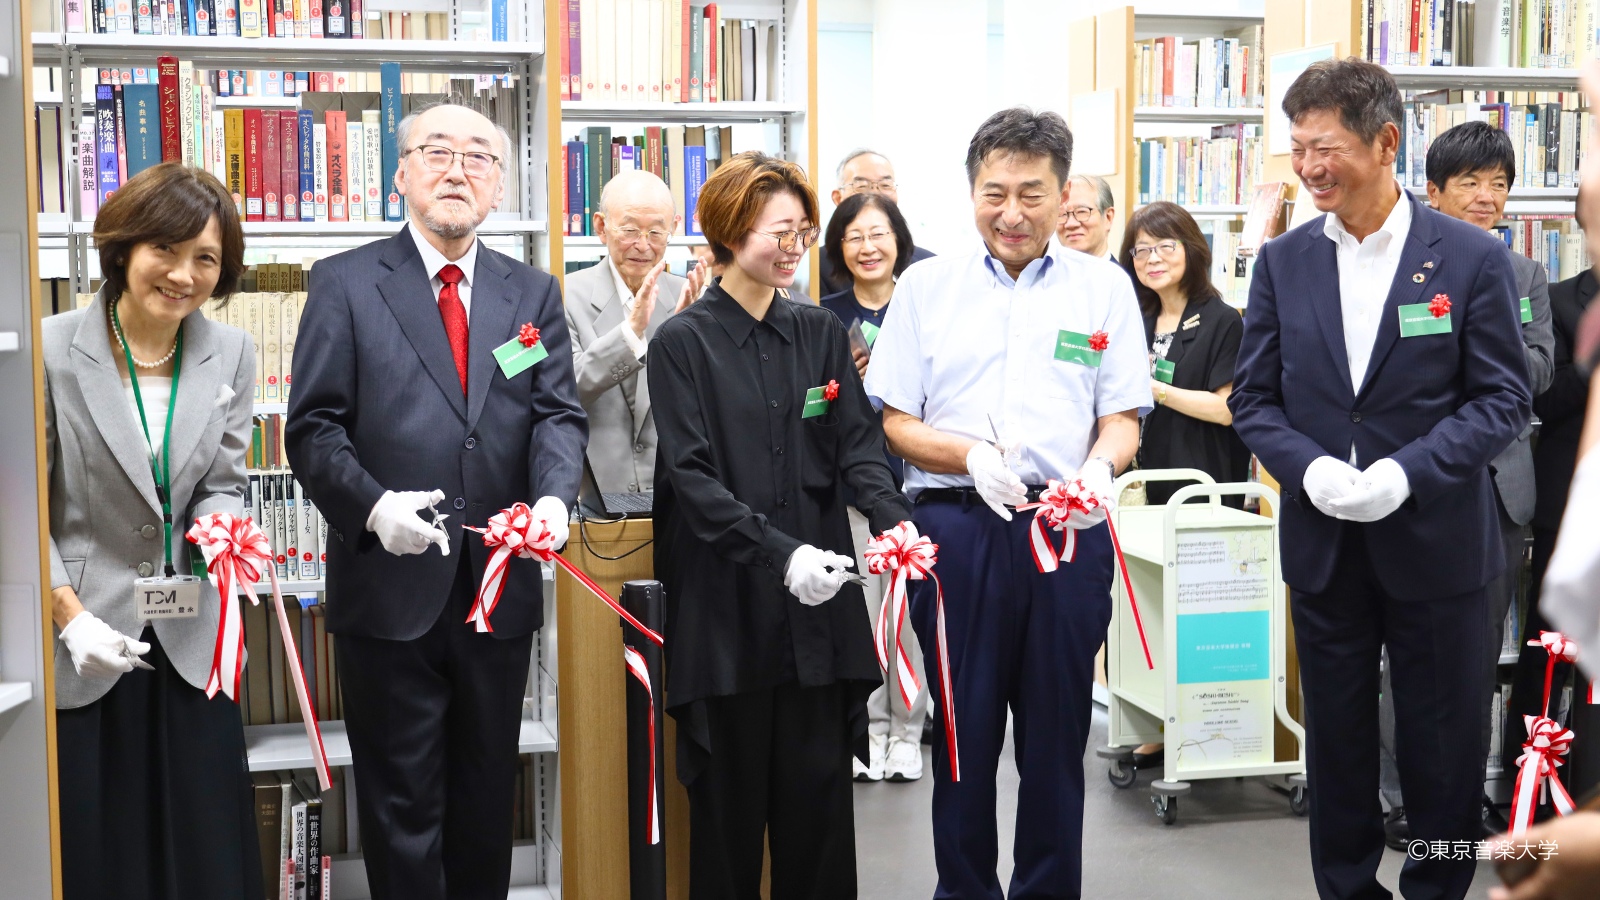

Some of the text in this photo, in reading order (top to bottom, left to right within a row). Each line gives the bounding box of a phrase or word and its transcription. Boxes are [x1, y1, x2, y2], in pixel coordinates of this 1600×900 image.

[102, 108, 115, 153] 吹奏楽曲
[138, 100, 147, 134] 名曲事典
[82, 142, 95, 191] 楽曲解説
[331, 153, 343, 196] オペラ全集
[276, 508, 284, 538] ブルックナー
[295, 811, 304, 873] 世界の音楽大図鑑
[309, 821, 319, 875] 世界の作曲家
